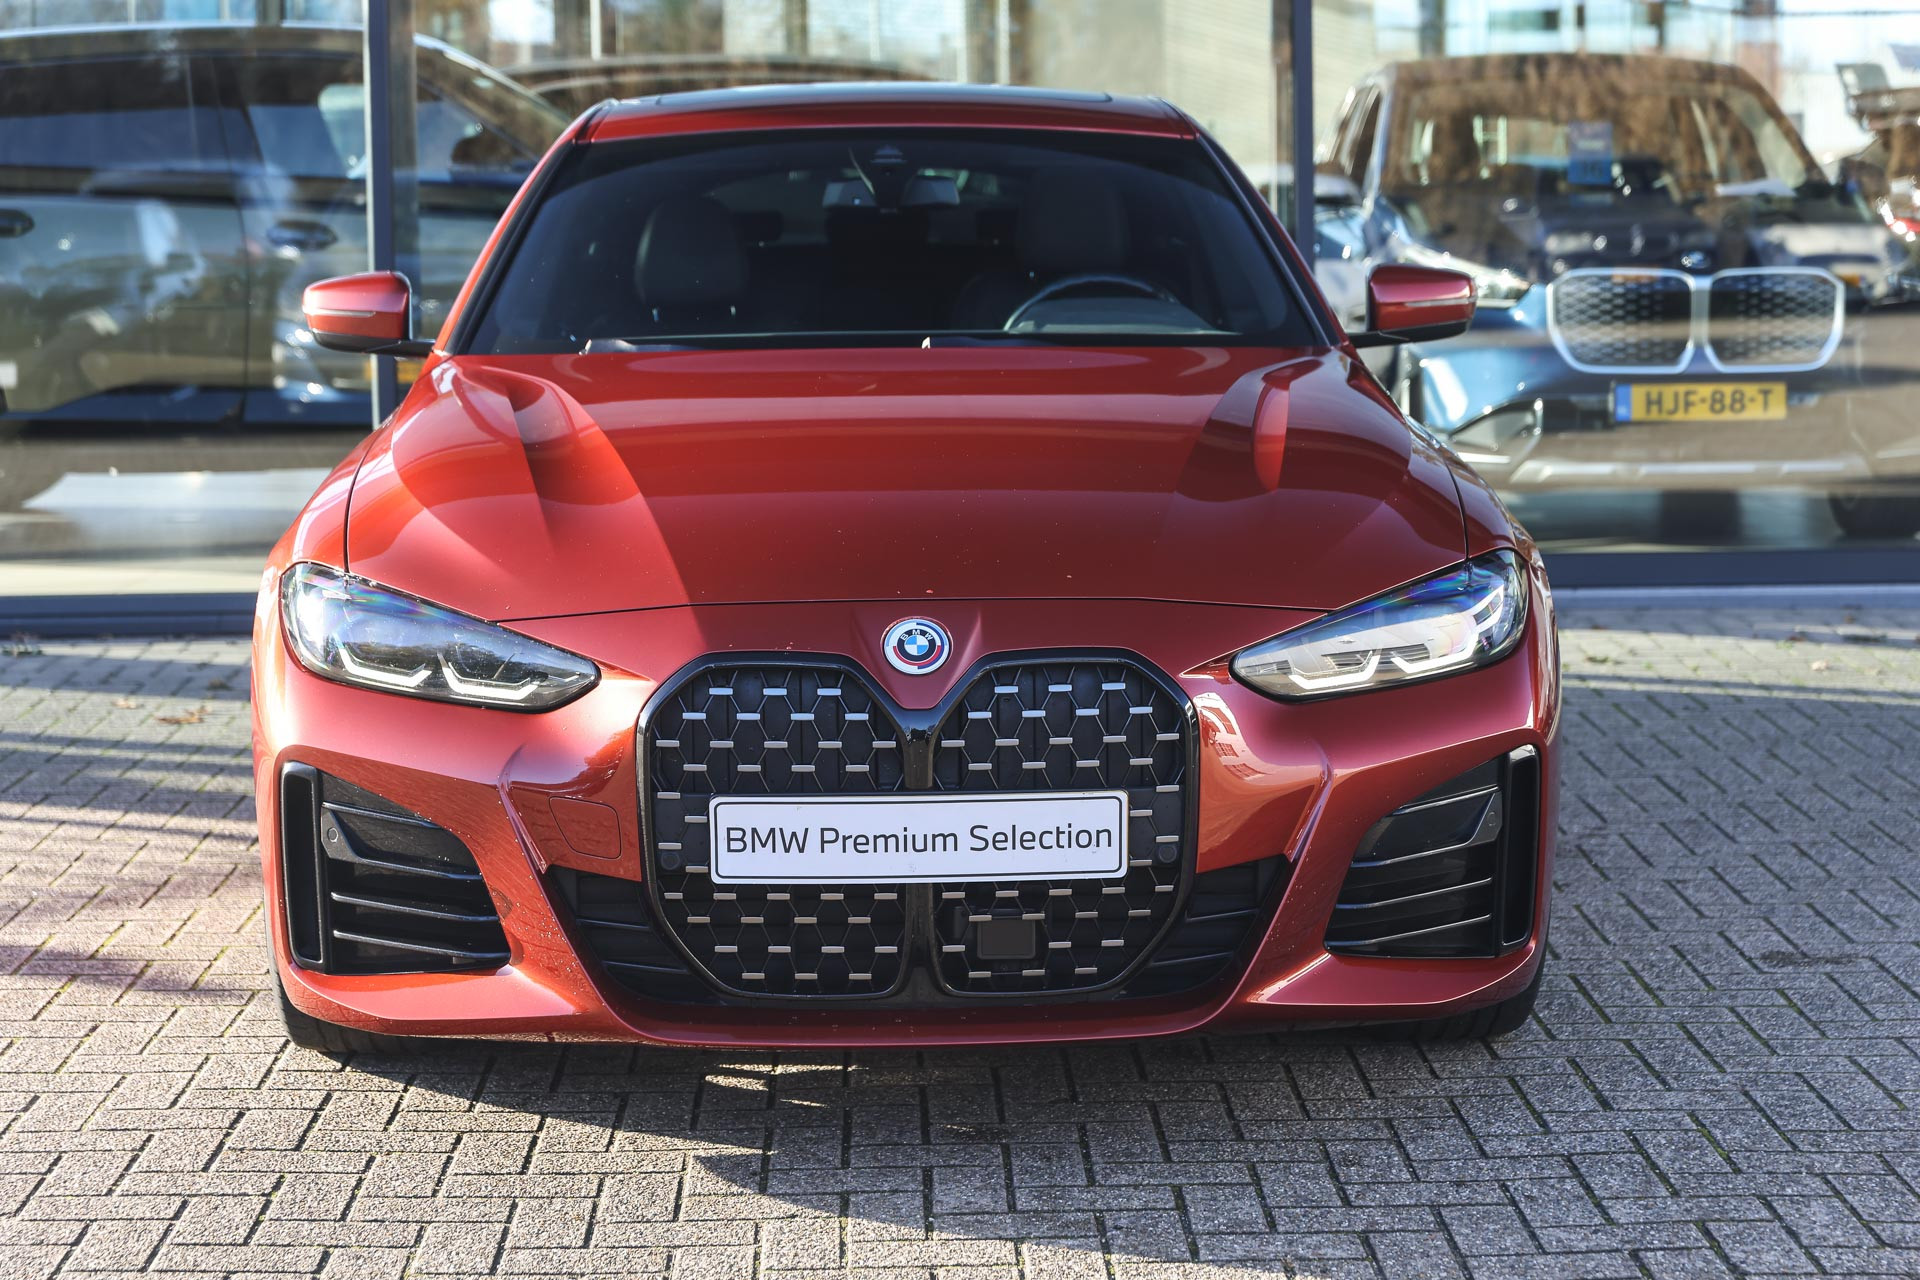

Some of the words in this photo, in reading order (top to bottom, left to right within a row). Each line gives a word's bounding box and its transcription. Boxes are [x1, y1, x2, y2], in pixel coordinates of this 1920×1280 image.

[1645, 389, 1773, 416] HJF-88-T
[899, 629, 934, 641] BMW
[725, 827, 809, 854] BMW
[820, 826, 958, 854] Premium
[969, 822, 1112, 852] Selection
